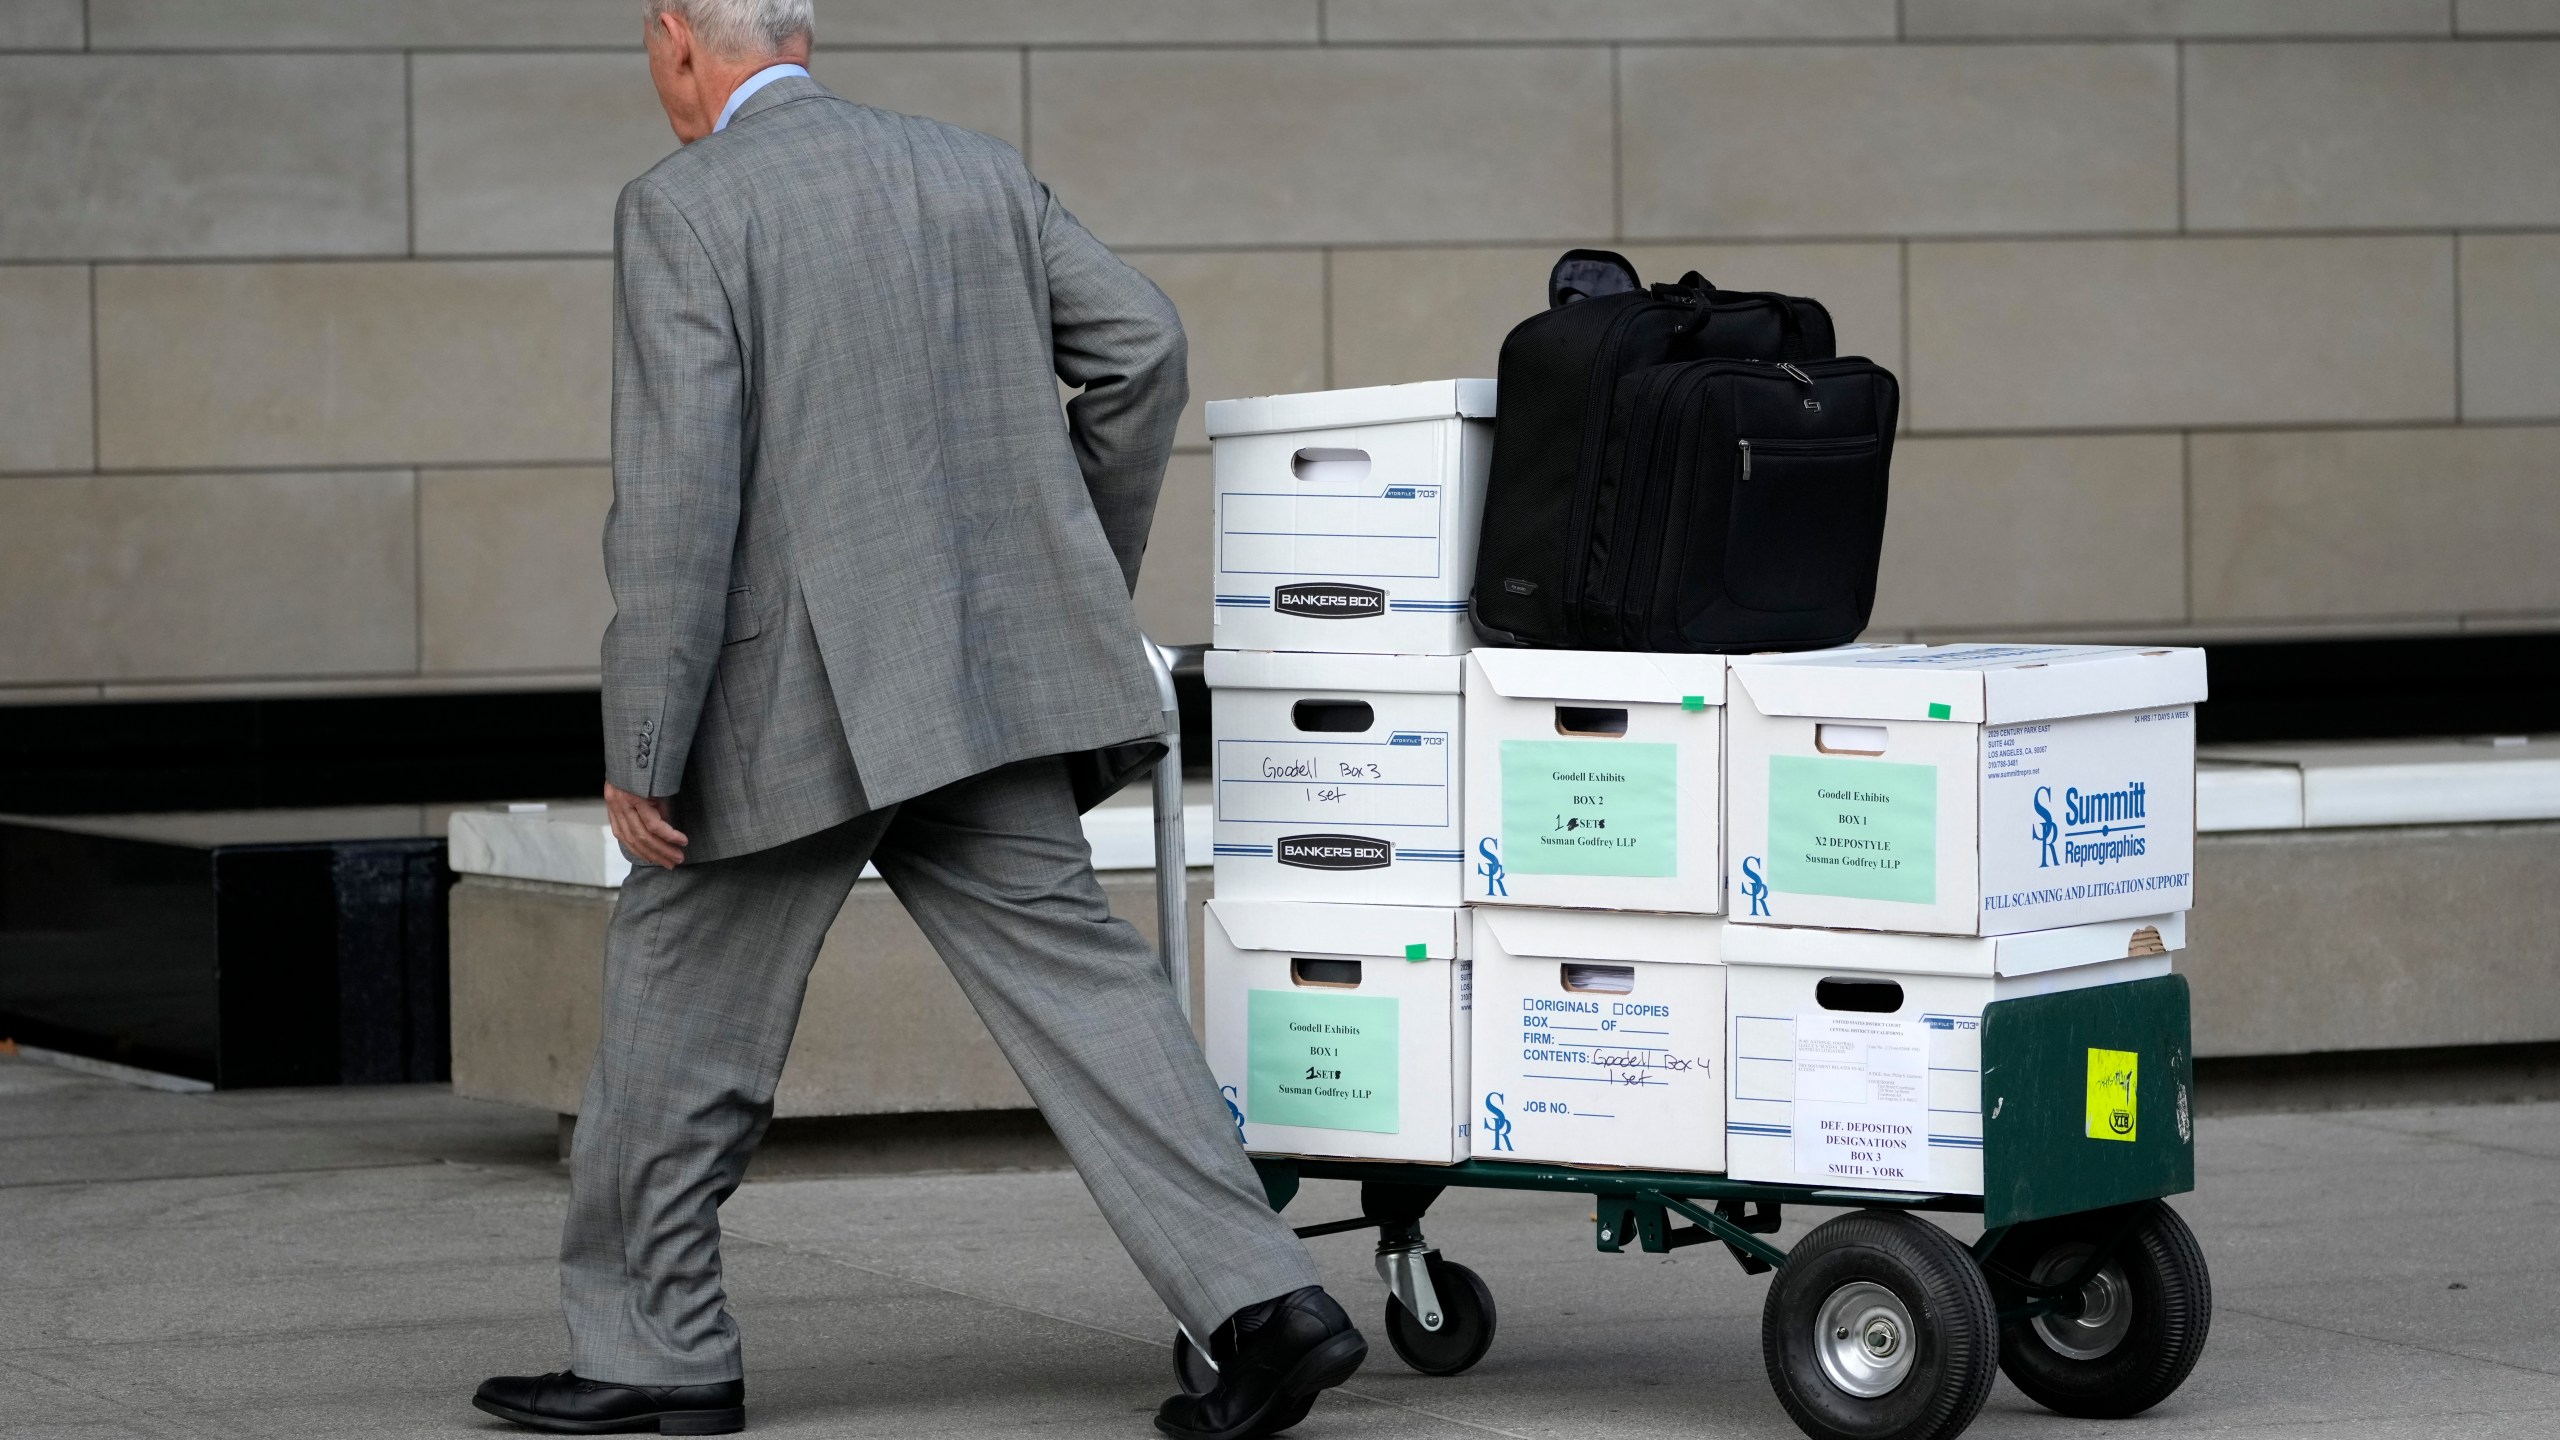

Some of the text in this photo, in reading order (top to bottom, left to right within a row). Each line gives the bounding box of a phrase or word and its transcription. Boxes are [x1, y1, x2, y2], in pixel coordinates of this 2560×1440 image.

[1282, 594, 1378, 607] BANKERS BOX
[2175, 711, 2189, 719] WEEK
[2000, 727, 2023, 737] CENTURY
[2024, 726, 2037, 734] PARK
[2038, 724, 2051, 733] EAST
[1988, 740, 2002, 748] SUITE
[1988, 751, 1998, 759] LOS
[1263, 757, 1381, 779] Goodell Box 3
[1553, 771, 1625, 782] Goodell Exhibits
[1318, 787, 1346, 803] set
[1573, 795, 1604, 805] BOX 2
[1818, 789, 1890, 803] Goodell Exhibits
[2065, 781, 2145, 826] Summitt
[1839, 814, 1867, 825] BOX 1
[1541, 835, 1637, 849] Susman Godfrey LLP
[1815, 836, 1891, 851] X2 DEPOSTYLE
[1285, 845, 1384, 858] BANKERS BOX
[2065, 834, 2145, 867] Reprographics
[1805, 853, 1901, 870] Susman Godfrey LLP
[1985, 873, 2189, 910] FULL SCANNING AND LITIGATION SUPPORT
[1535, 1000, 1670, 1017] ORIGINALS COPIES
[1289, 1022, 1360, 1035] Goodell Exhibits
[1524, 1016, 1617, 1031] BOX OF
[1956, 1021, 1976, 1030] 703
[1524, 1033, 1555, 1045] FIRM:
[1310, 1046, 1338, 1057] BOX 1
[1523, 1049, 1590, 1064] CONTENTS:
[1593, 1049, 1711, 1079] Goodell Box 4
[1621, 1070, 1653, 1087] set
[1279, 1084, 1372, 1099] Susman Godfrey LLP
[1523, 1101, 1570, 1114] JOB NO.
[1820, 1120, 1912, 1135] DEF. DEPOSITION
[2114, 1115, 2129, 1128] BTX
[1826, 1135, 1907, 1149] DESIGNATIONS
[1851, 1151, 1882, 1162] BOX 3
[1828, 1164, 1863, 1175] SMITH
[1872, 1166, 1904, 1178] YORK
